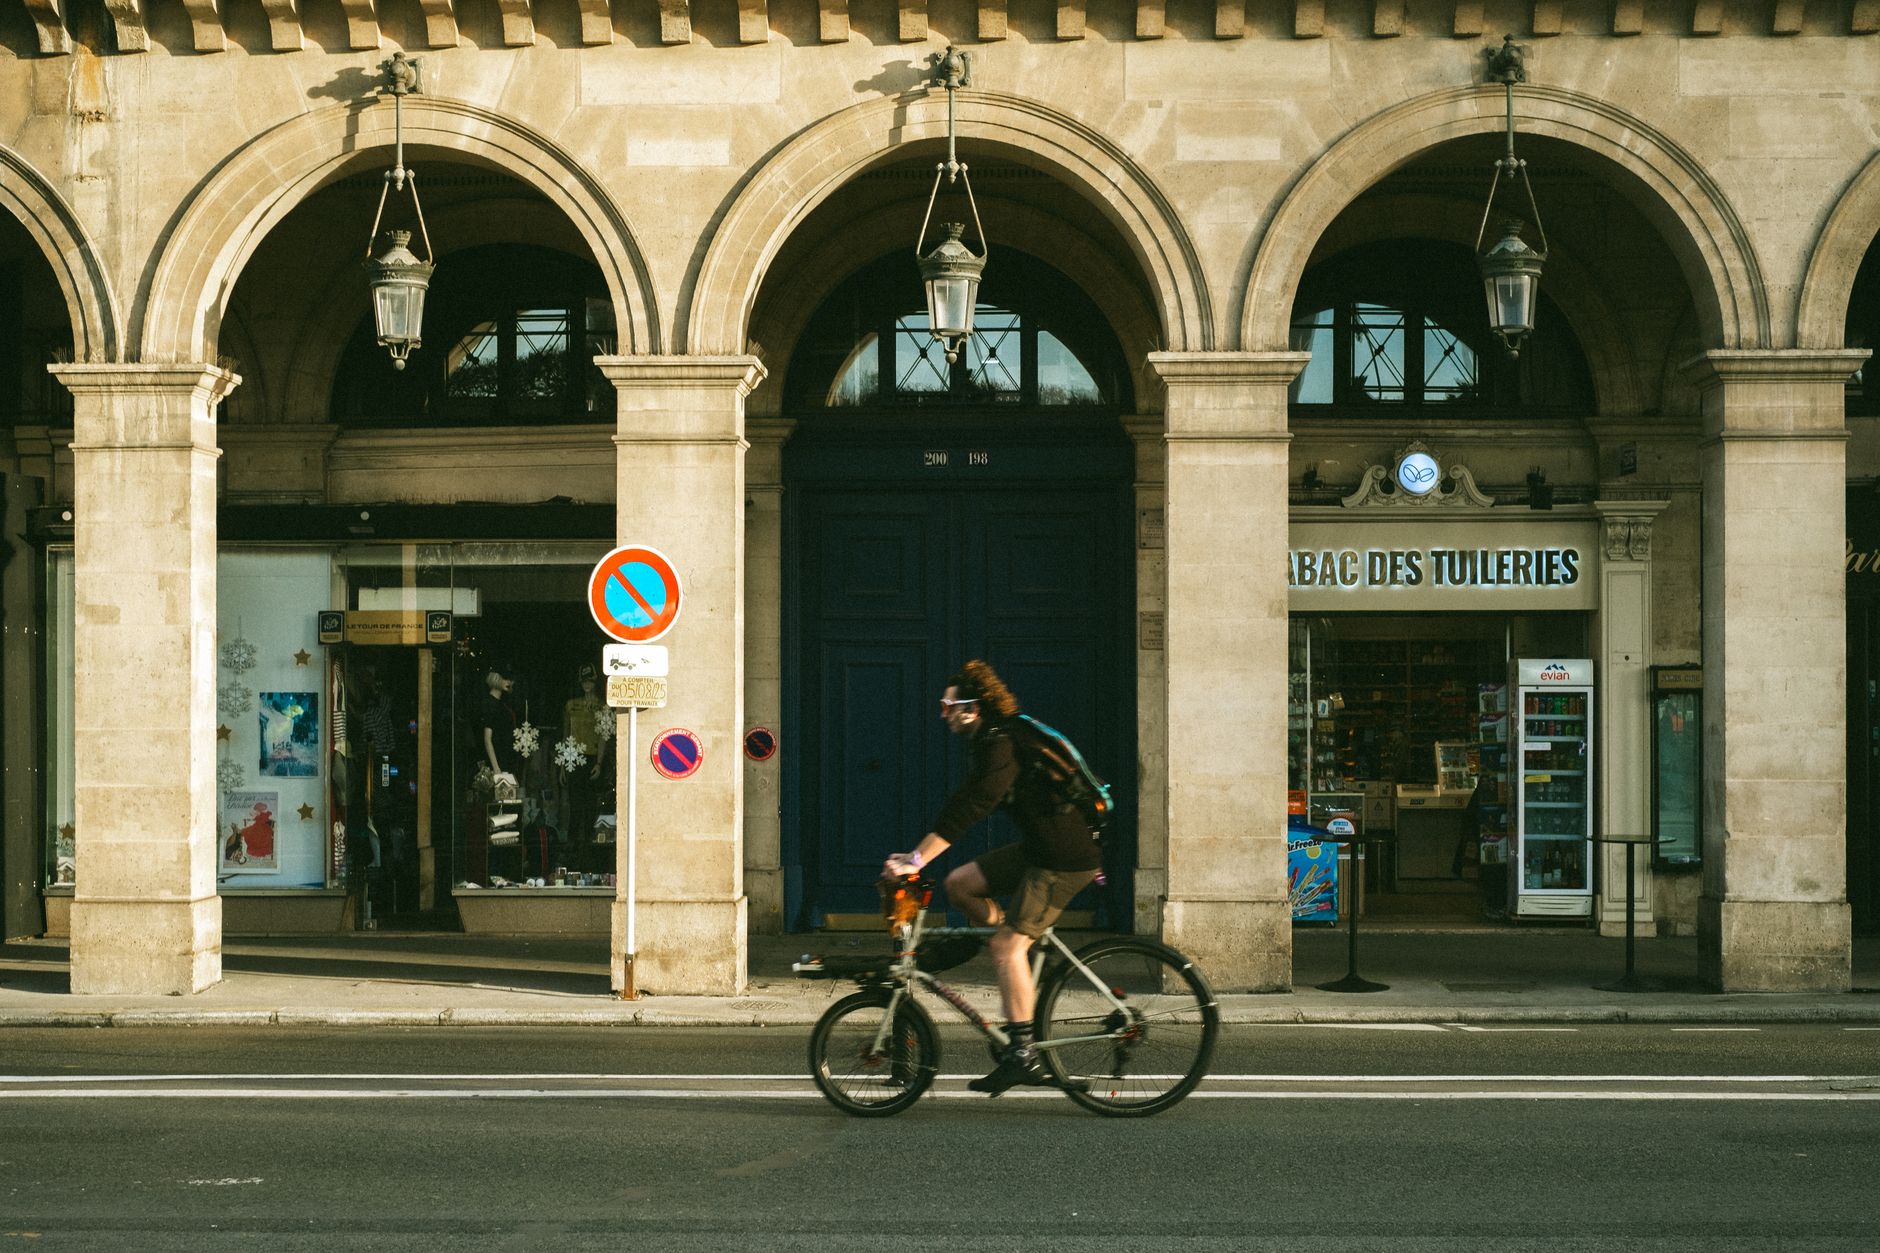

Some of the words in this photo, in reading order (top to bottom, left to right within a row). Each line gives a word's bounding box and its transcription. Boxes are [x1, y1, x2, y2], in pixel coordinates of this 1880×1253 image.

[925, 452, 947, 465] 200
[969, 452, 988, 465] 198
[1368, 551, 1423, 586] DES
[1431, 549, 1579, 586] TUILERIES
[1541, 671, 1570, 680] evian
